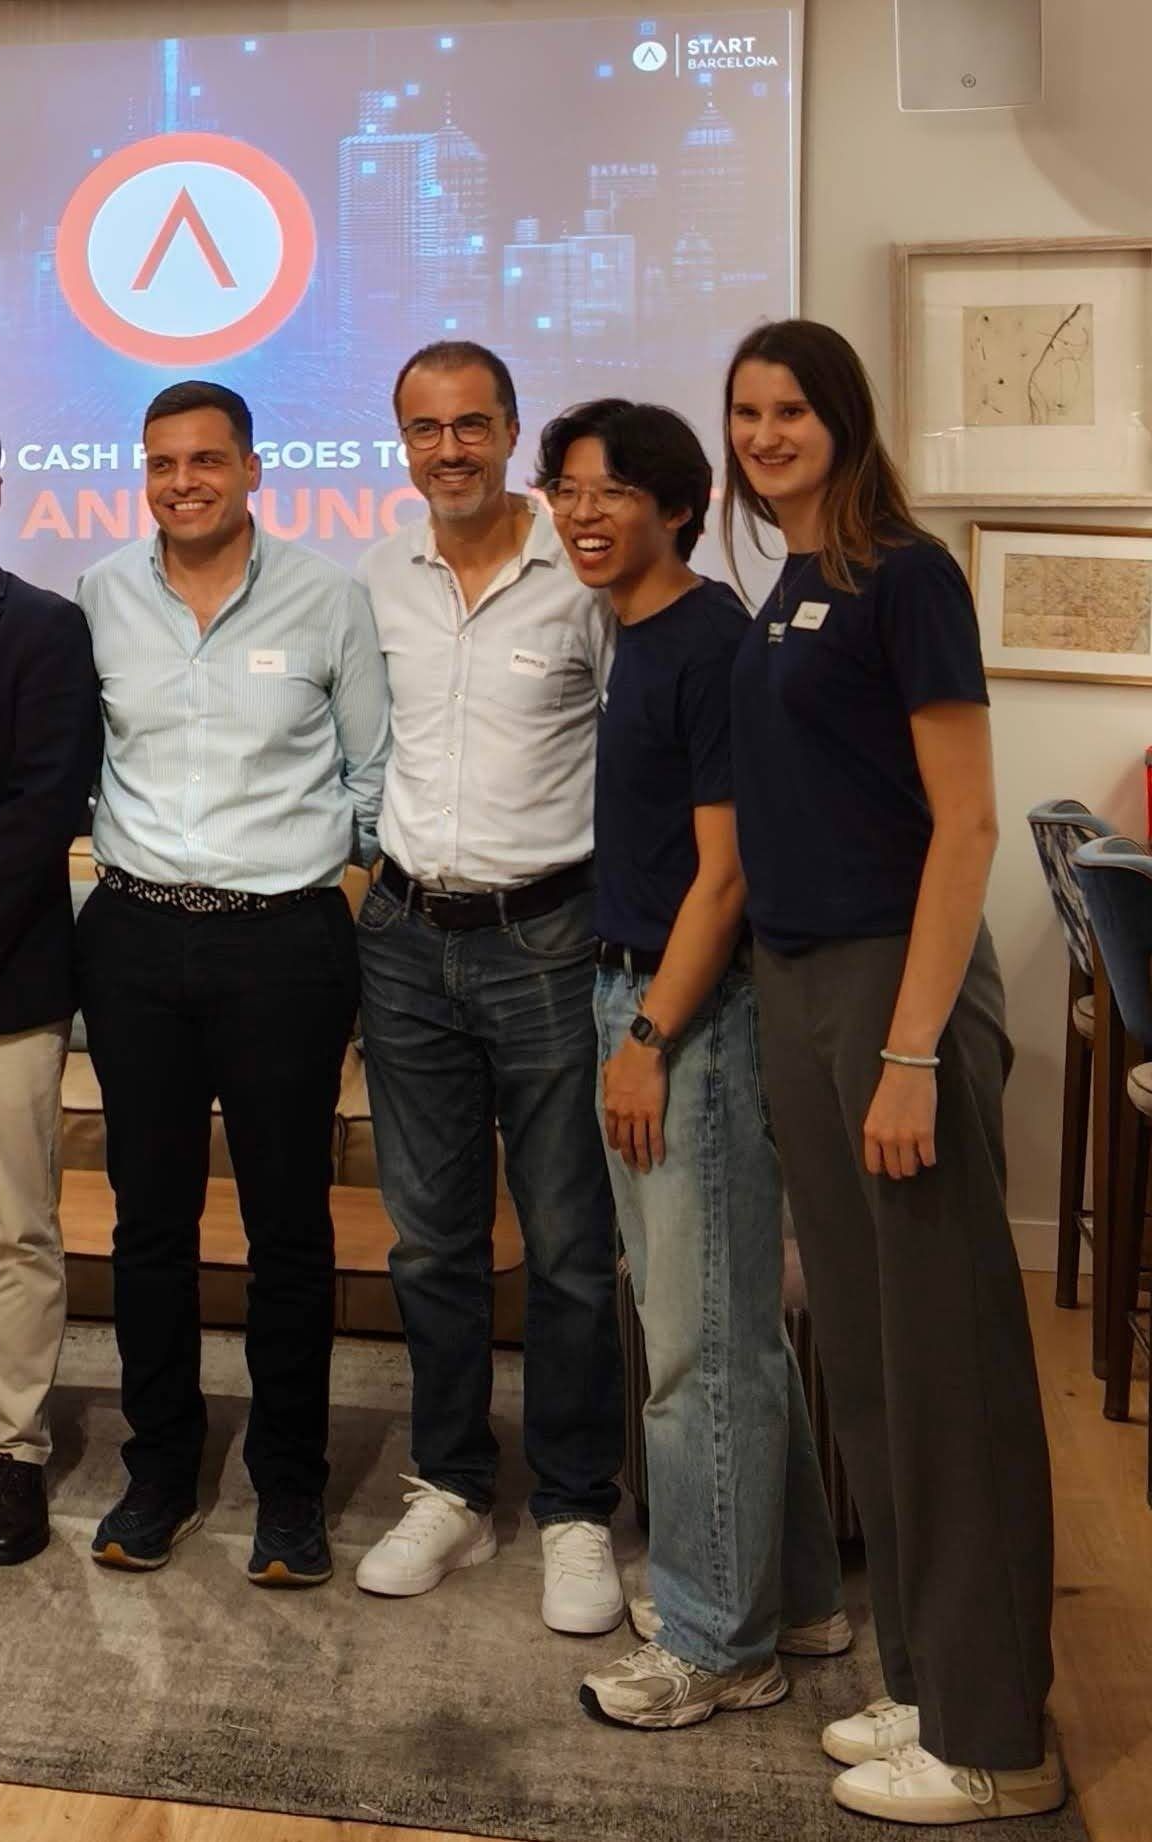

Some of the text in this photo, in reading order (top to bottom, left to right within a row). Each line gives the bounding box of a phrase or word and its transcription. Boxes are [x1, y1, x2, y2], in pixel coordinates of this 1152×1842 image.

[687, 36, 756, 55] START
[687, 56, 778, 70] BARCELONA
[17, 443, 119, 471] CASH
[254, 441, 361, 469] GOES
